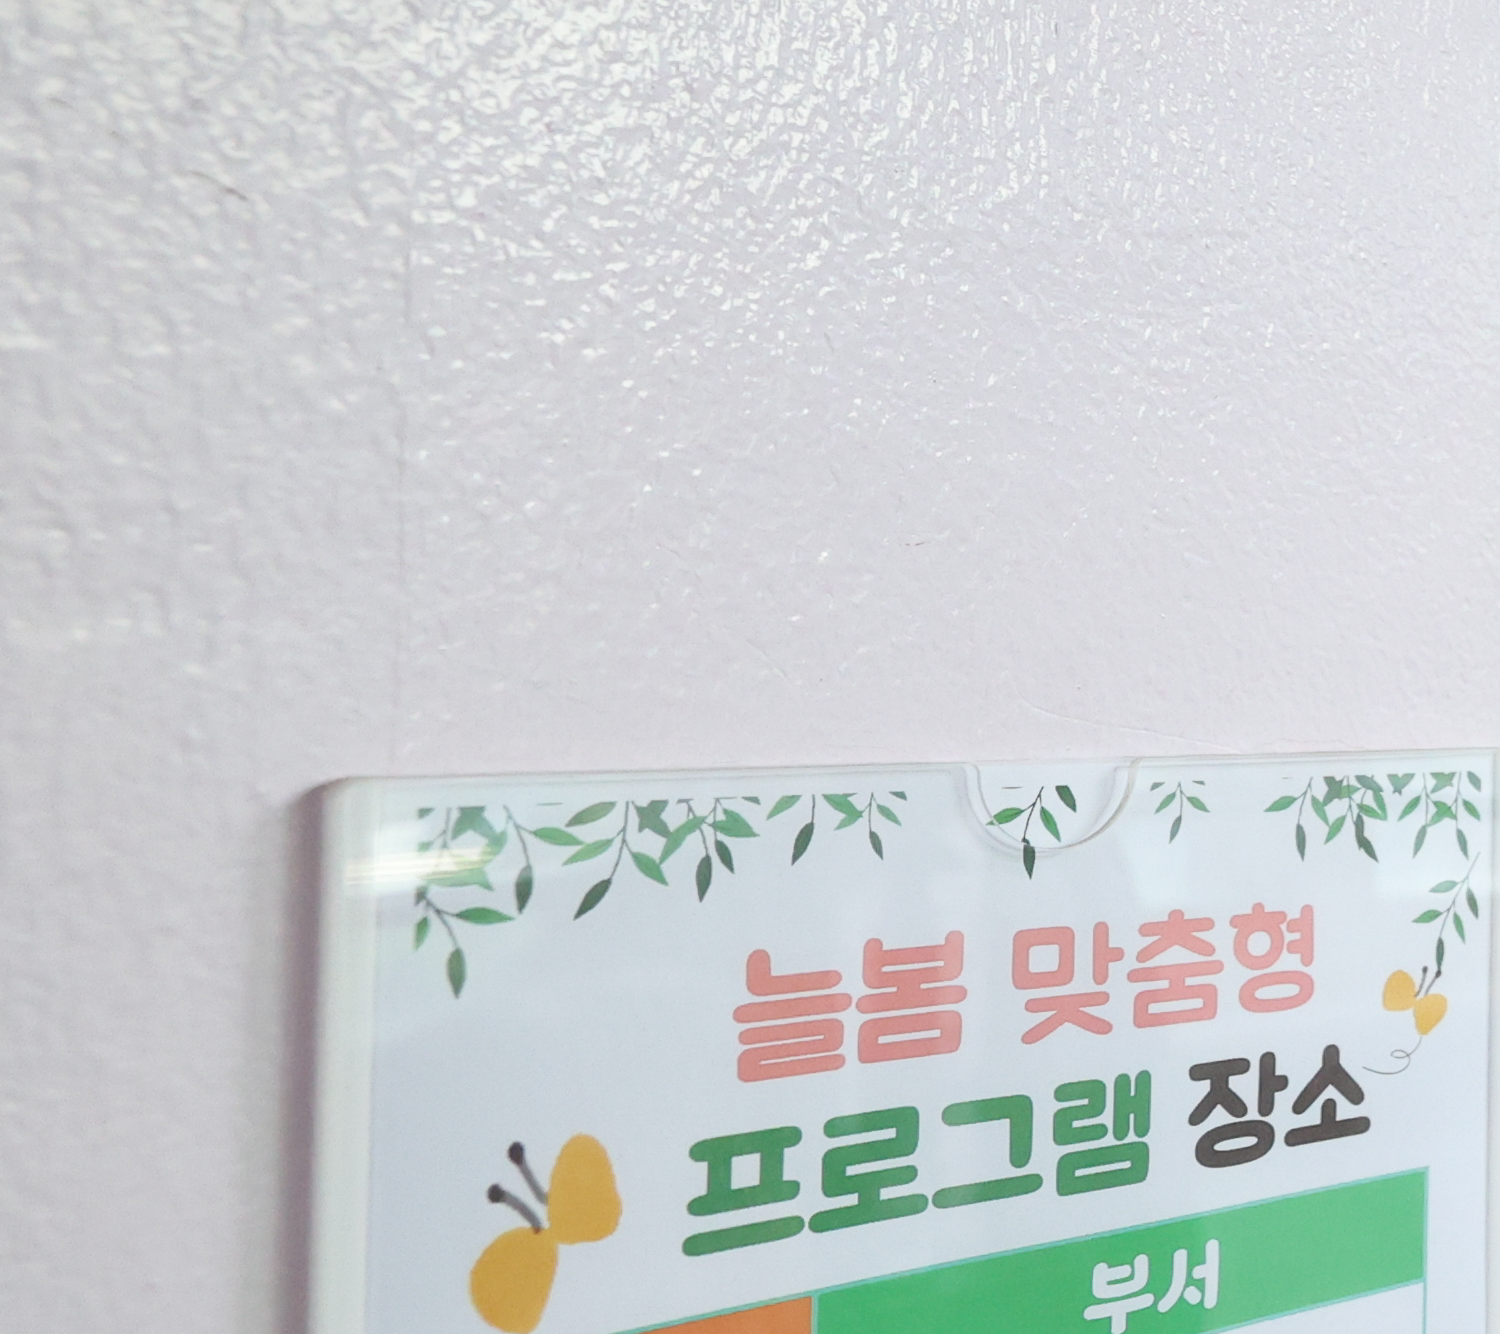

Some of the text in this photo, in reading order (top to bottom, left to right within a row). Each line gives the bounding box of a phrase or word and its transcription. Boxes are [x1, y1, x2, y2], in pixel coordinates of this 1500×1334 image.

[734, 903, 1314, 1082] 늘봄 맞춤형
[683, 1044, 1372, 1256] 프로그램 장소
[1083, 1238, 1221, 1334] 부서
